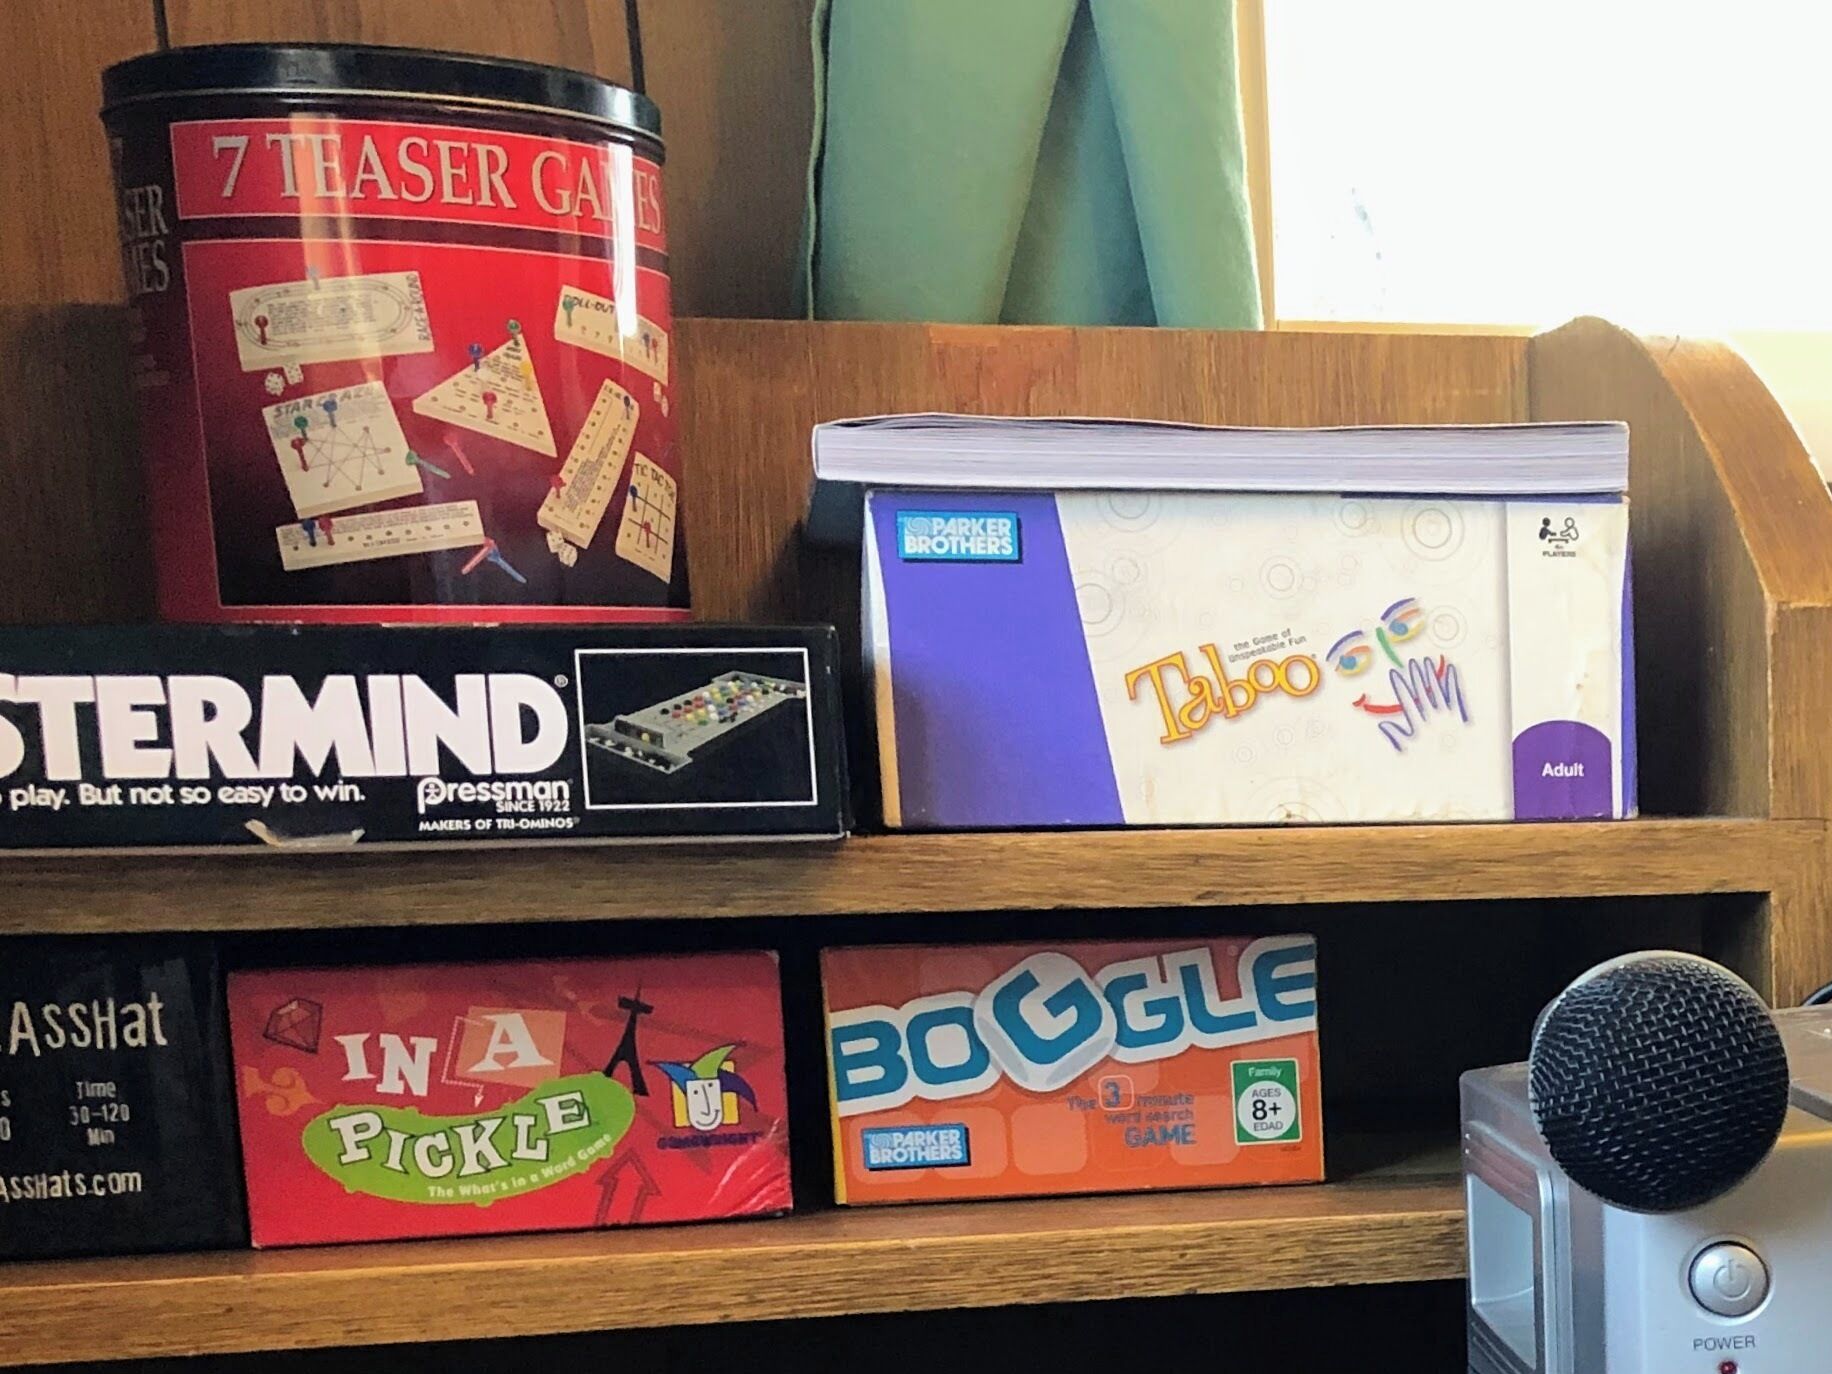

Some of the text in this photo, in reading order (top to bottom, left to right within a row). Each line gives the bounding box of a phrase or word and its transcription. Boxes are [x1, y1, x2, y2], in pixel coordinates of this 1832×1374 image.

[213, 133, 662, 234] 7 TEASER GAES
[932, 518, 1011, 536] PARKER
[904, 535, 1013, 555] BROTHERS
[1125, 643, 1320, 746] Taboo
[1541, 761, 1585, 780] Adult
[11, 781, 366, 811] play. But not so easy to win.
[496, 800, 570, 813] SINCE 1922
[419, 817, 574, 831] MAKERS OF TRI-OMINOS
[831, 940, 1317, 1106] BOGGLE
[334, 1012, 547, 1097] IN A
[1248, 1067, 1282, 1079] Family
[76, 1081, 117, 1099] Time
[1103, 1081, 1120, 1107] 3
[1251, 1088, 1281, 1098] AGES
[69, 1103, 130, 1126] 30-120
[1145, 1107, 1194, 1122] search
[1252, 1099, 1282, 1121] 8+
[328, 1090, 593, 1180] PICKLE
[1253, 1121, 1283, 1131] EDAD
[893, 1129, 960, 1147] PARKER
[1125, 1124, 1196, 1148] GAME
[869, 1146, 962, 1164] BROTHERS
[427, 1186, 454, 1198] The
[459, 1181, 509, 1197] What's
[541, 1157, 576, 1179] Word
[577, 1133, 612, 1161] Game
[1692, 1335, 1756, 1351] POWER
